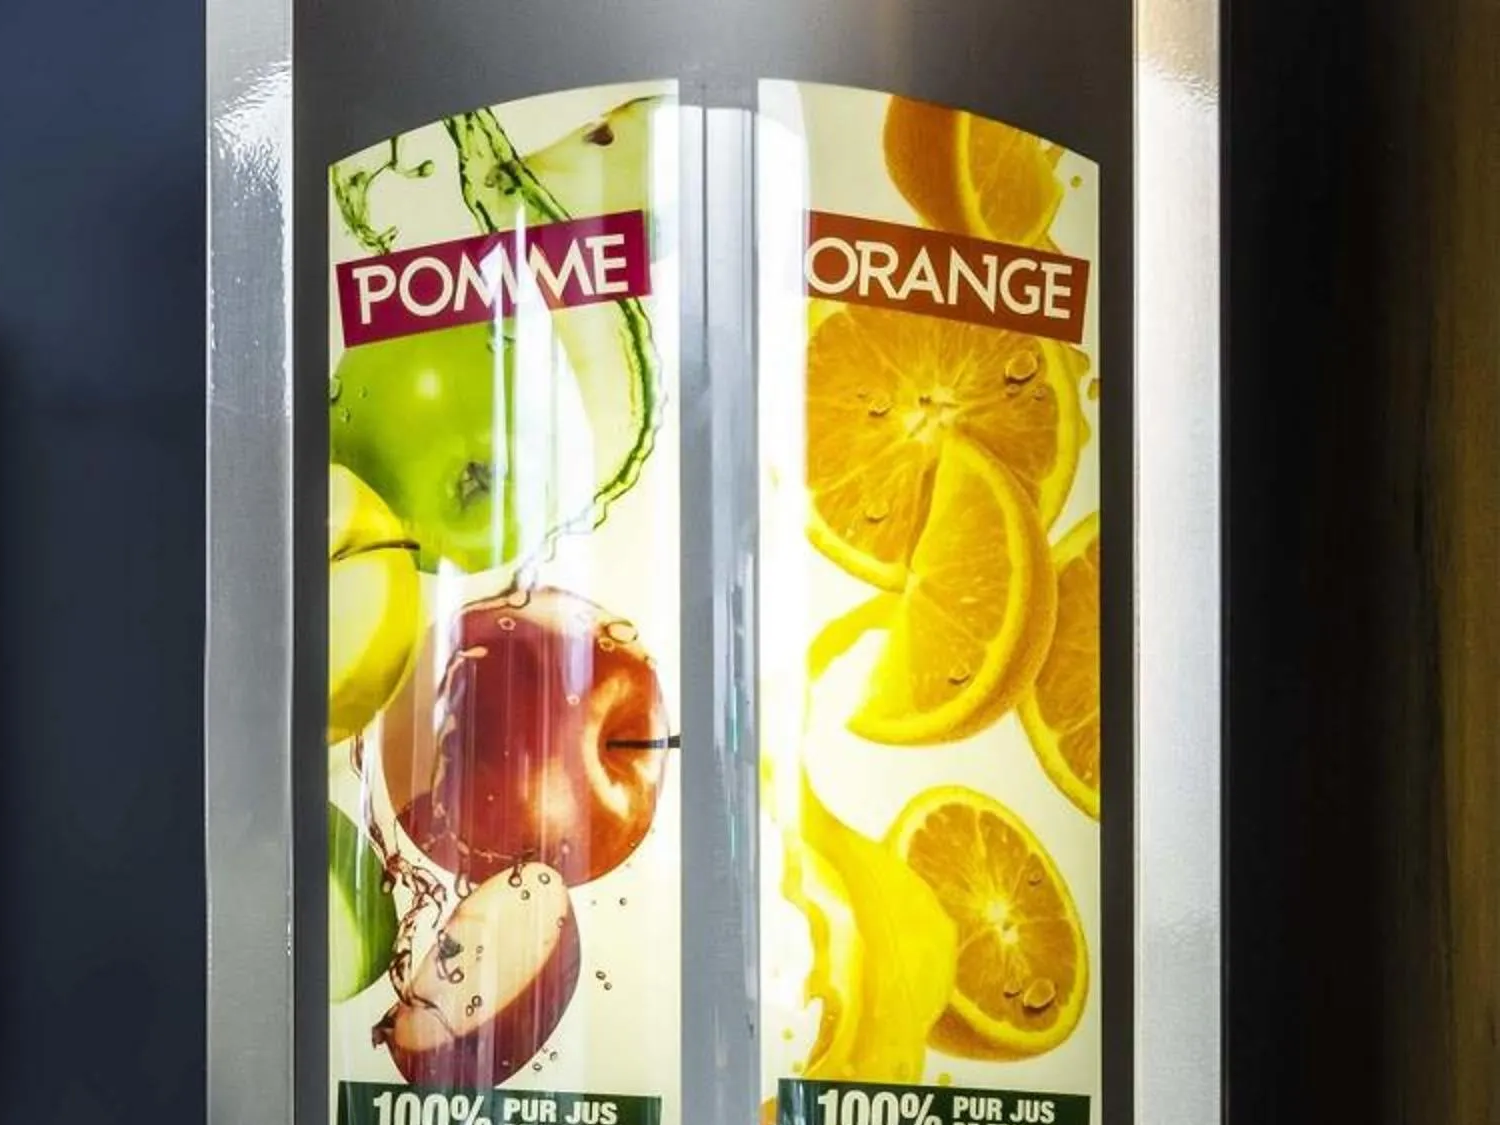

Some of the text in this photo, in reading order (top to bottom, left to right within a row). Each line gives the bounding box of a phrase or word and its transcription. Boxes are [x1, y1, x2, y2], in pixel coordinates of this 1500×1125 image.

[352, 233, 629, 325] POMME
[804, 237, 1073, 319] ORANGE
[503, 1097, 557, 1123] PUR
[565, 1100, 618, 1125] JUS
[952, 1095, 1004, 1121] PUR
[1009, 1098, 1055, 1124] JUS
